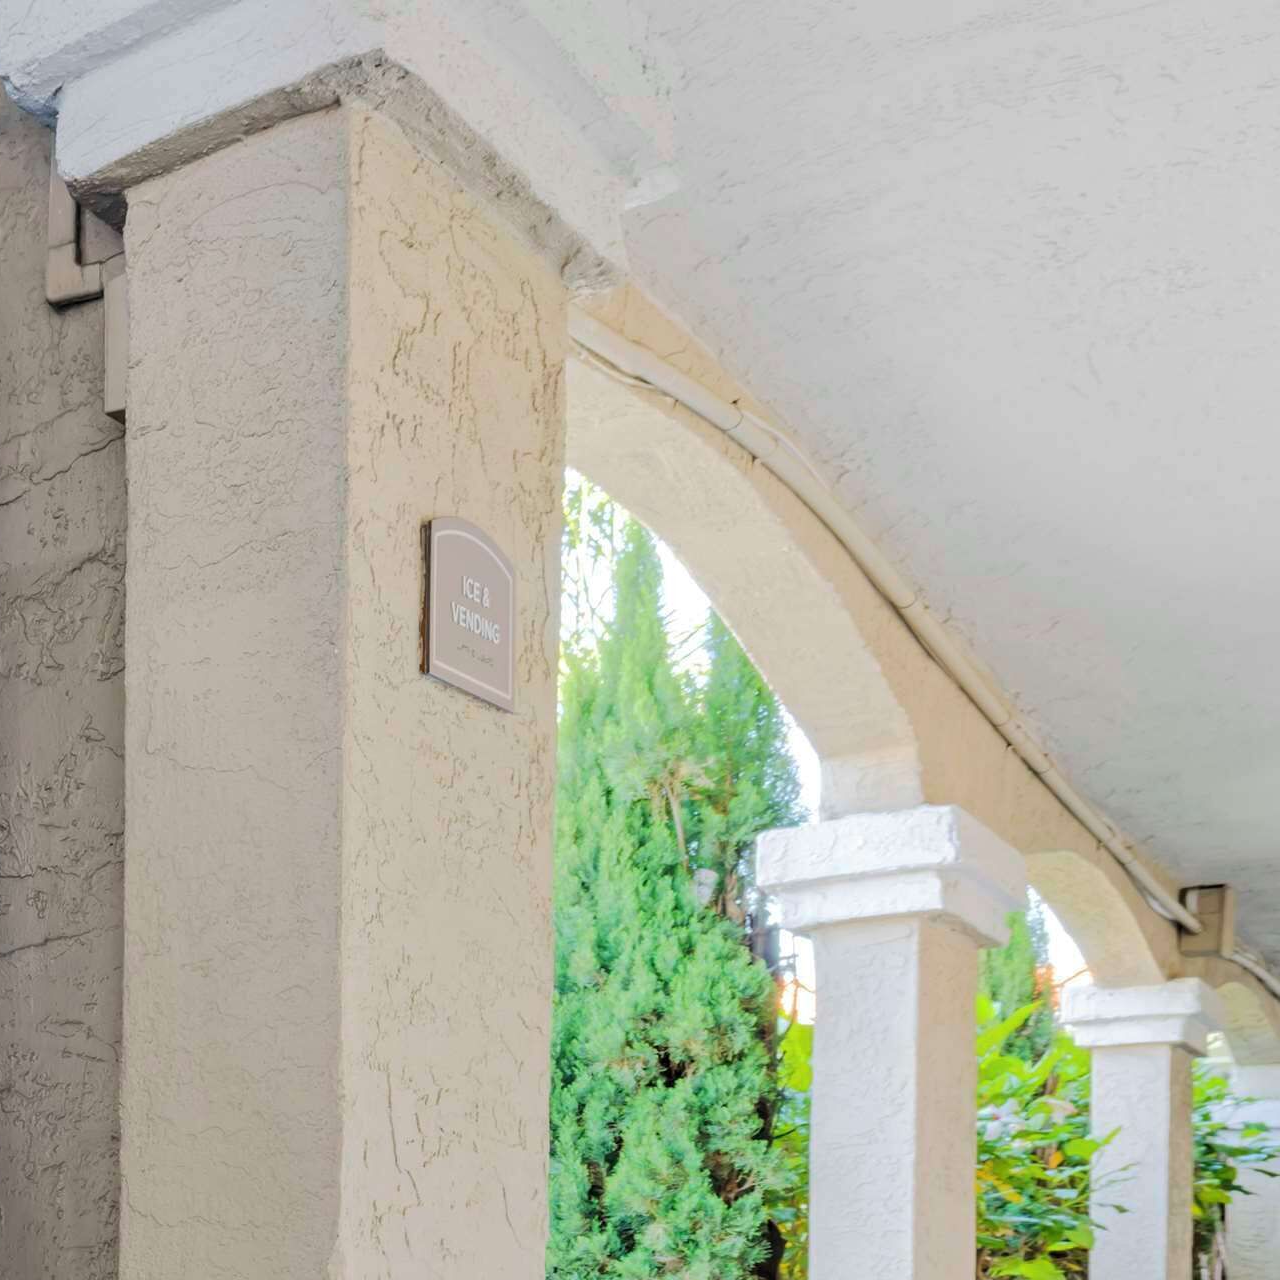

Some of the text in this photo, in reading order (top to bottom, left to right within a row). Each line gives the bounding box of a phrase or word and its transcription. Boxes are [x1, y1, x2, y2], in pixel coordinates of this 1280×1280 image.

[463, 575, 490, 608] ICE &
[451, 601, 501, 644] VENDING
